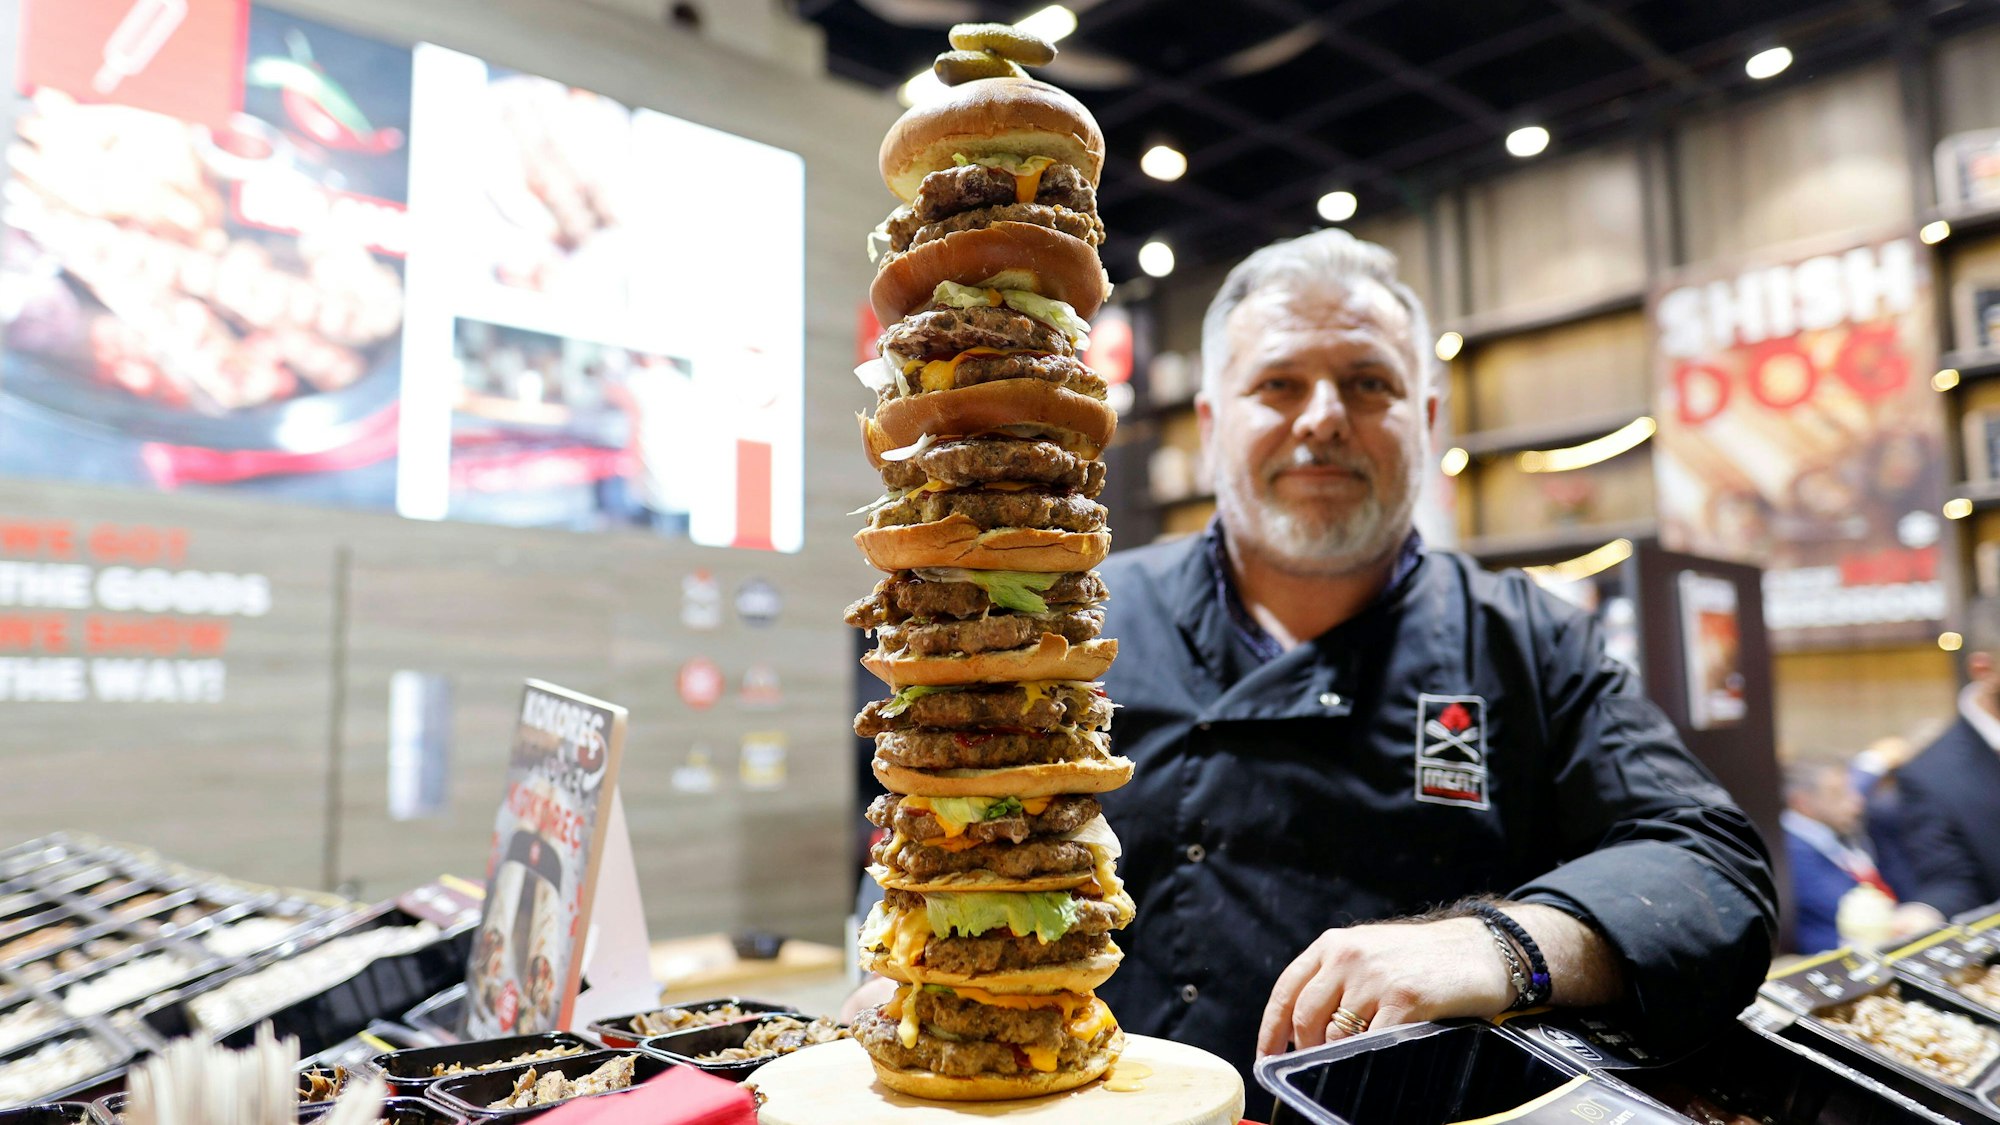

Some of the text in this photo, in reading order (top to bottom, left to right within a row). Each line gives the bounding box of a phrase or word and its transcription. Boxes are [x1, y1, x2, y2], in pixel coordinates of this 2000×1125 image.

[1658, 241, 1916, 357] SHISH
[1673, 323, 1911, 427] DOG
[90, 523, 190, 566] GOT
[0, 560, 271, 617] THE GOODS
[83, 613, 231, 656] SHOW
